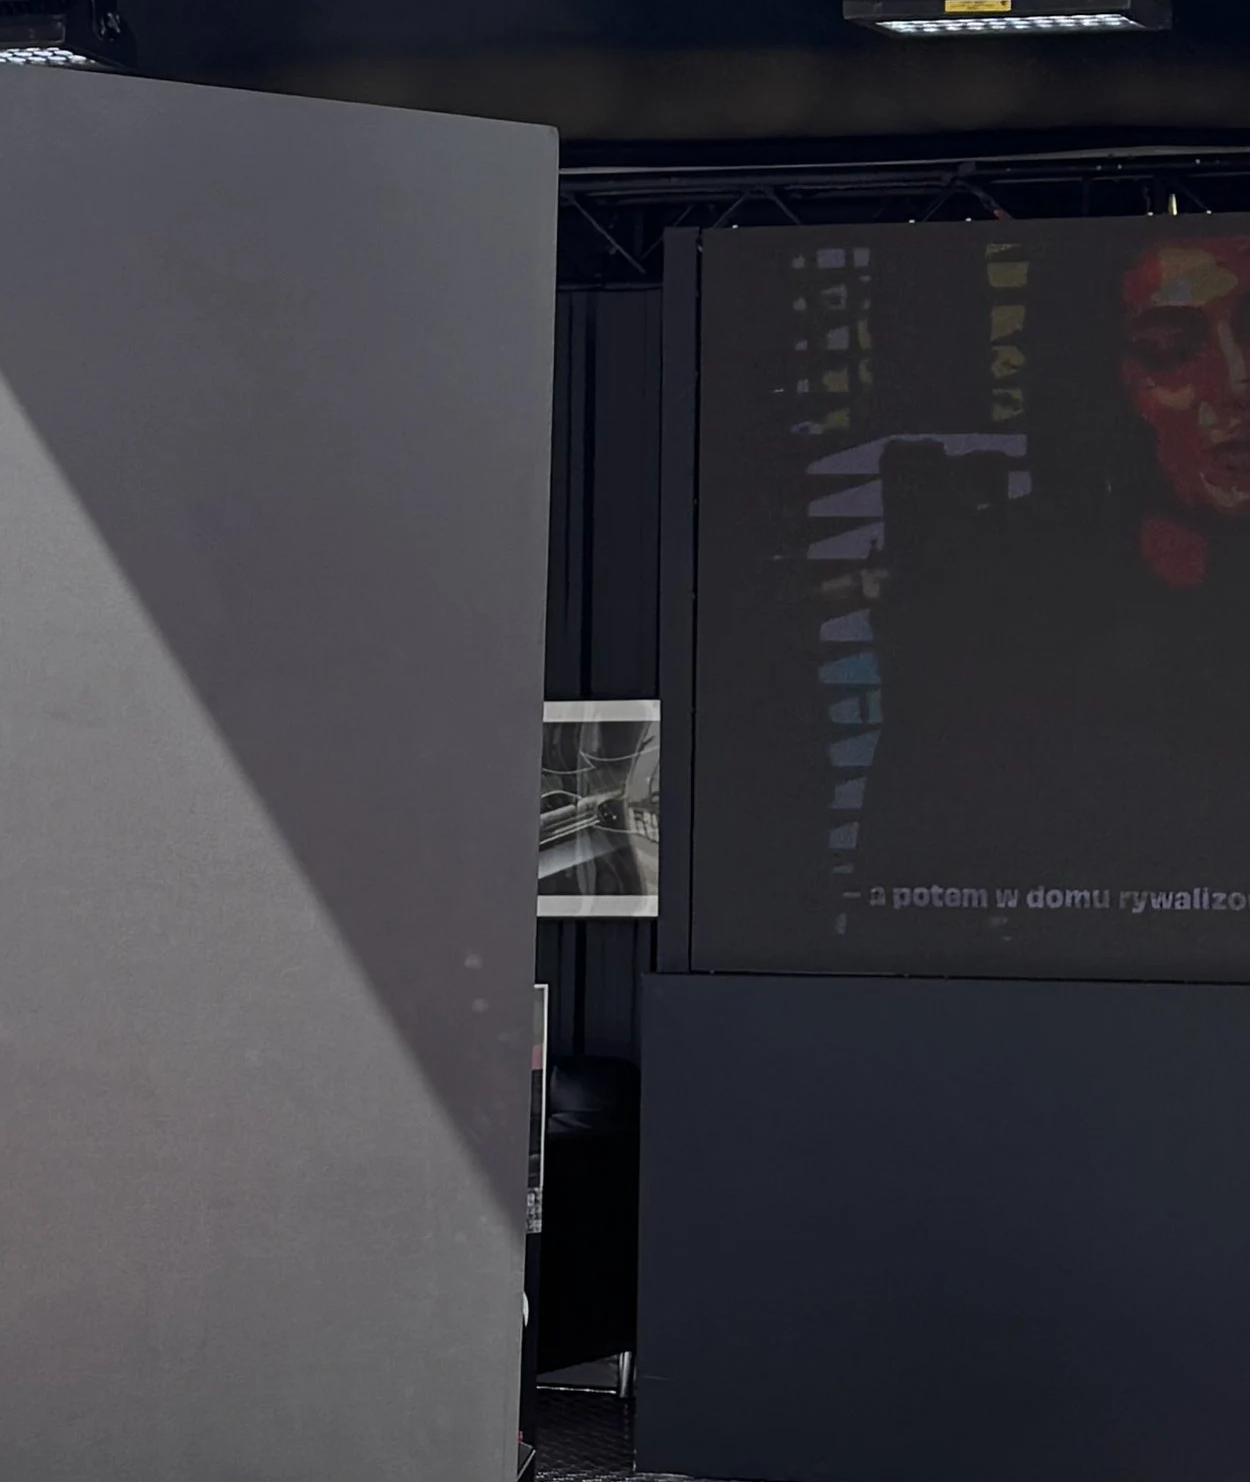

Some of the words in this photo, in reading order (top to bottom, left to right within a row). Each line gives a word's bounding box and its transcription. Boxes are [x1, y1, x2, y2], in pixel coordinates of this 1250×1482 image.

[868, 885, 887, 906] a
[892, 884, 989, 911] potem
[995, 887, 1020, 909] w
[1027, 884, 1110, 910] domu
